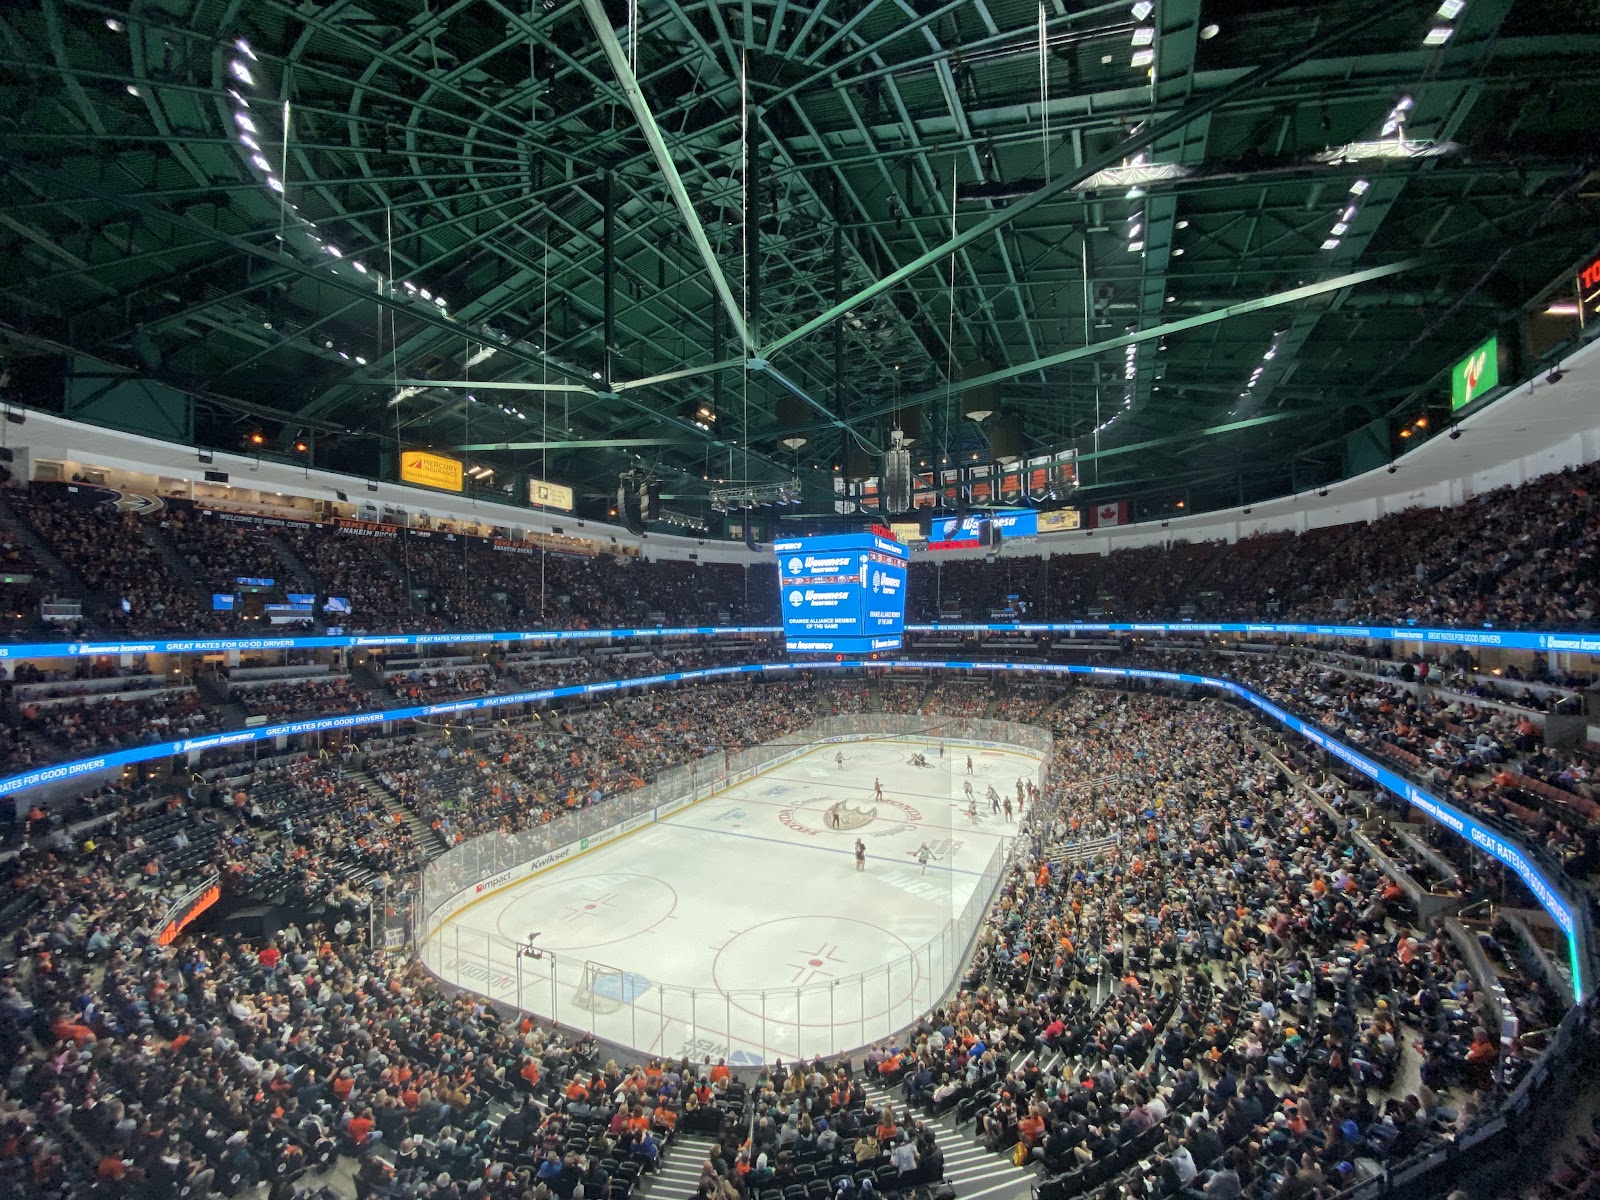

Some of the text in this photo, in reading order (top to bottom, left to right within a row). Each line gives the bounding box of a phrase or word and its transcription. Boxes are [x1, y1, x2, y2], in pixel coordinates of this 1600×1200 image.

[423, 459, 458, 471] MERCURY
[423, 466, 458, 478] INSURANCE
[220, 514, 252, 522] WELCOME
[286, 521, 310, 530] CENTER
[340, 520, 365, 529] HOME
[339, 527, 373, 537] ANAHEIM
[804, 556, 850, 568] Wawanesa
[804, 590, 850, 601] Wawanesa
[797, 640, 834, 650] Insurance
[1479, 635, 1500, 644] DRIVERS
[80, 644, 156, 654] Wawanesa Insurance
[483, 698, 499, 706] GREAT
[266, 714, 384, 736] GREAT RATES FOR GOOD DRIVERS
[184, 732, 255, 750] Wawanesa Insurance
[24, 774, 39, 788] FOR
[40, 767, 67, 781] GOOD
[69, 759, 105, 775] DRIVERS
[1412, 790, 1463, 831] Wawanesa Insurance
[531, 849, 570, 871] Kwikset
[1471, 828, 1495, 852] GREAT
[1520, 860, 1530, 879] FOR
[1531, 872, 1546, 900] GOOD
[482, 872, 512, 891] impact
[684, 1038, 728, 1056] WEST
